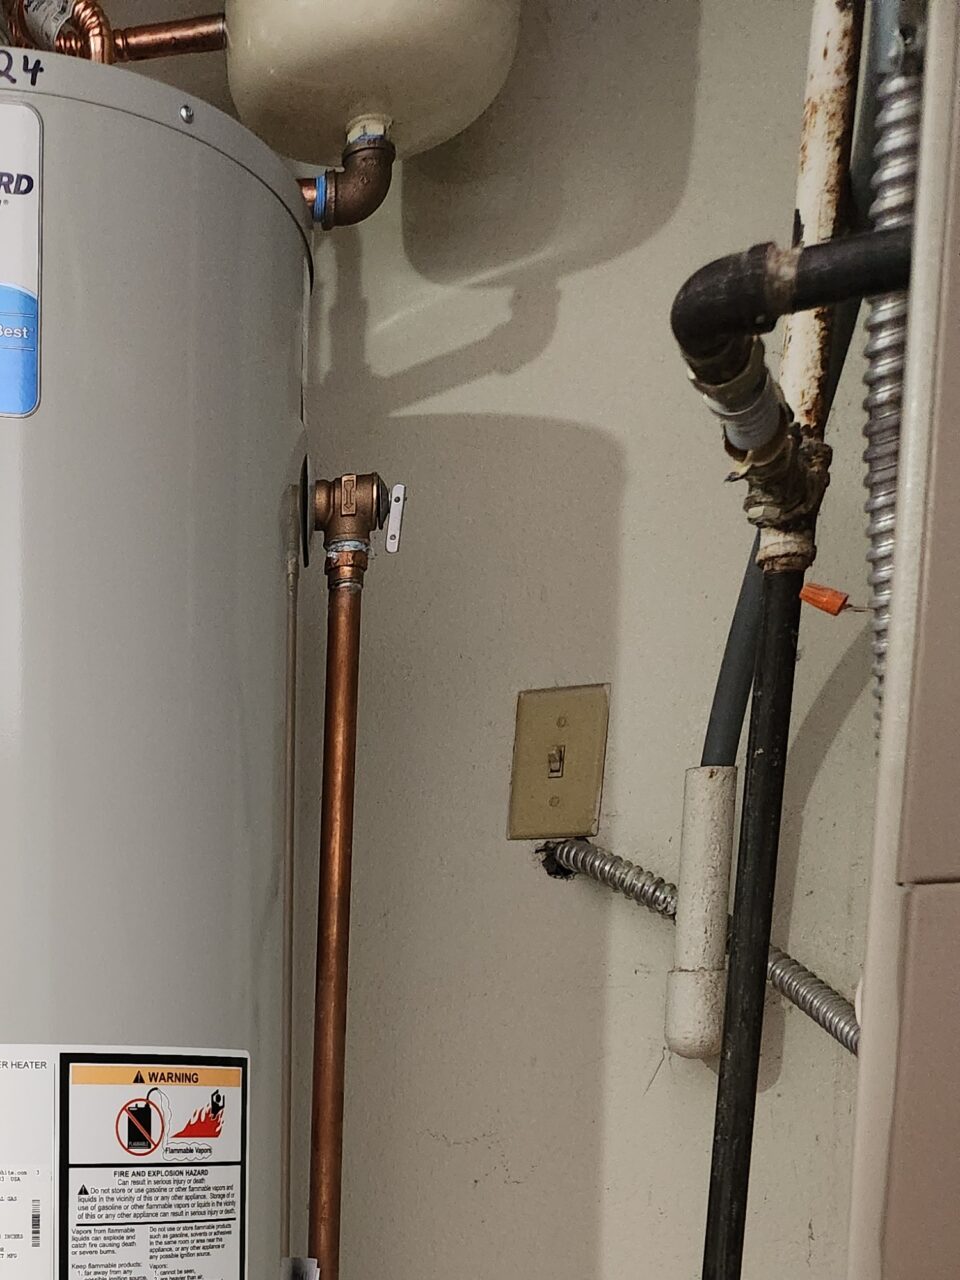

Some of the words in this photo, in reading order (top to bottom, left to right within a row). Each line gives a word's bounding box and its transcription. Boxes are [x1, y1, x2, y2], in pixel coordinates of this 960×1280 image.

[148, 1072, 199, 1083] WARNING
[145, 1186, 167, 1194] gasoline
[107, 1227, 135, 1235] flammable
[87, 1262, 116, 1270] flammable
